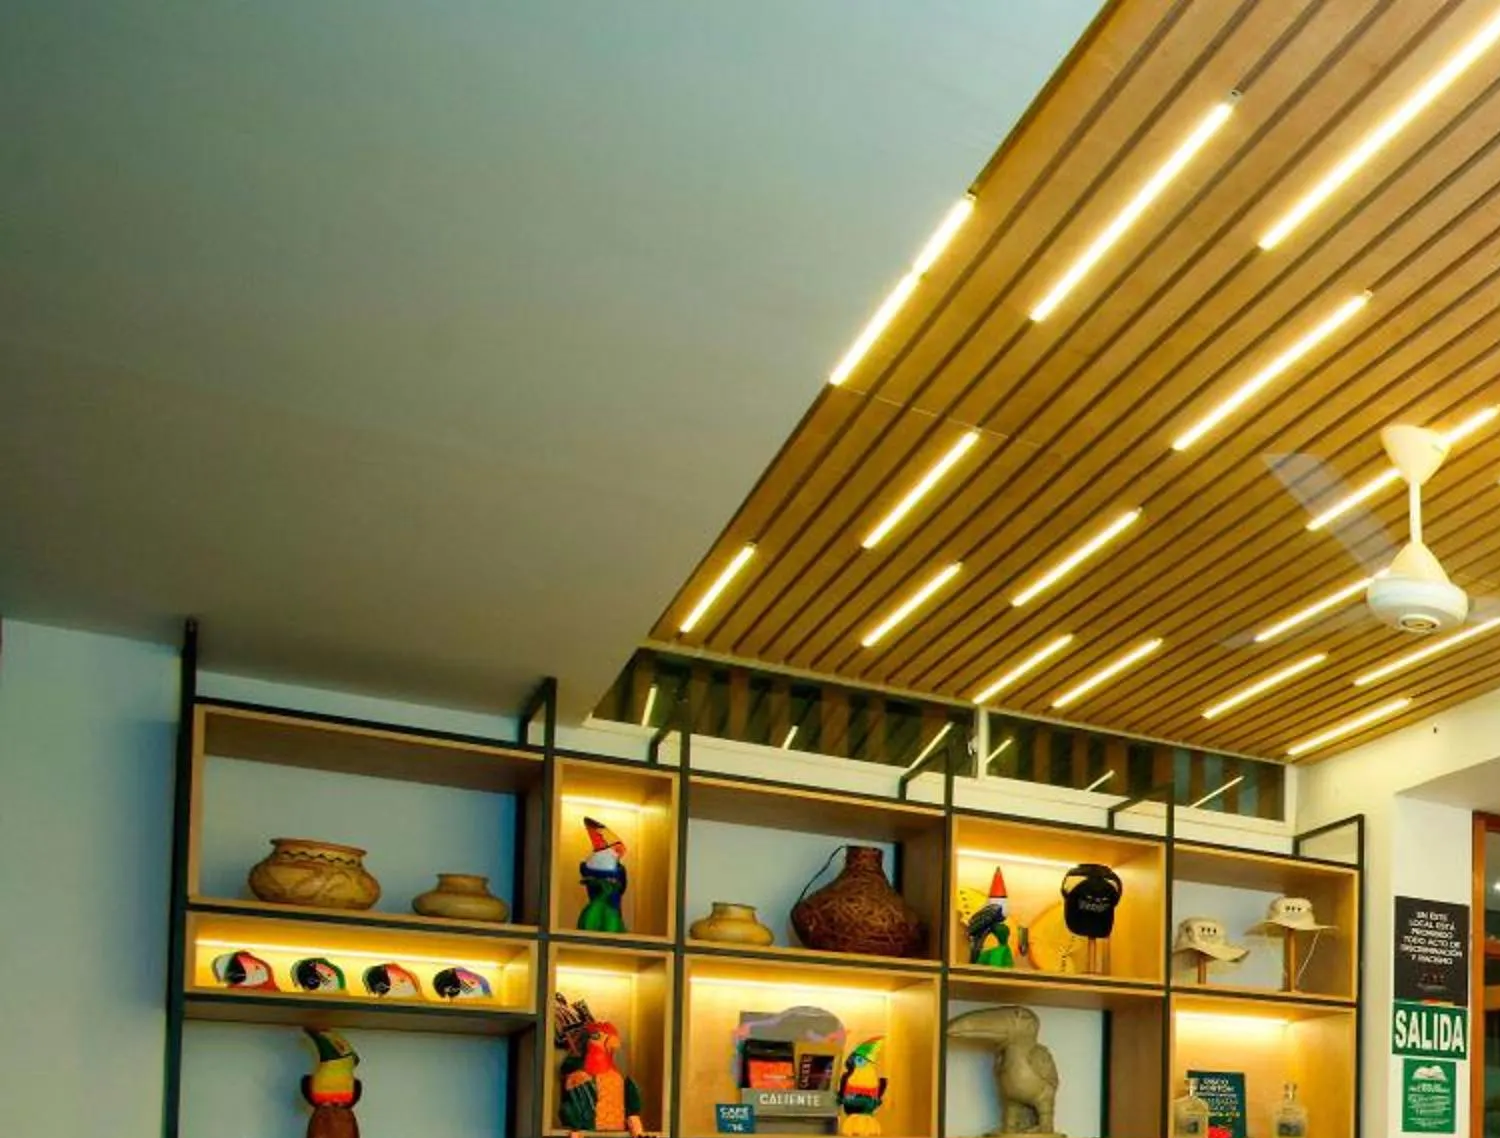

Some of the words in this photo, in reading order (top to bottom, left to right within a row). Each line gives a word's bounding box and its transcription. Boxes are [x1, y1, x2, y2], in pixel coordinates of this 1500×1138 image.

[1409, 919, 1434, 929] LOCAL
[1404, 935, 1427, 945] TODO
[1428, 938, 1449, 948] ACTO
[1450, 941, 1461, 949] DE
[1395, 1010, 1464, 1052] SALIDA
[759, 1093, 822, 1107] CALIENTE
